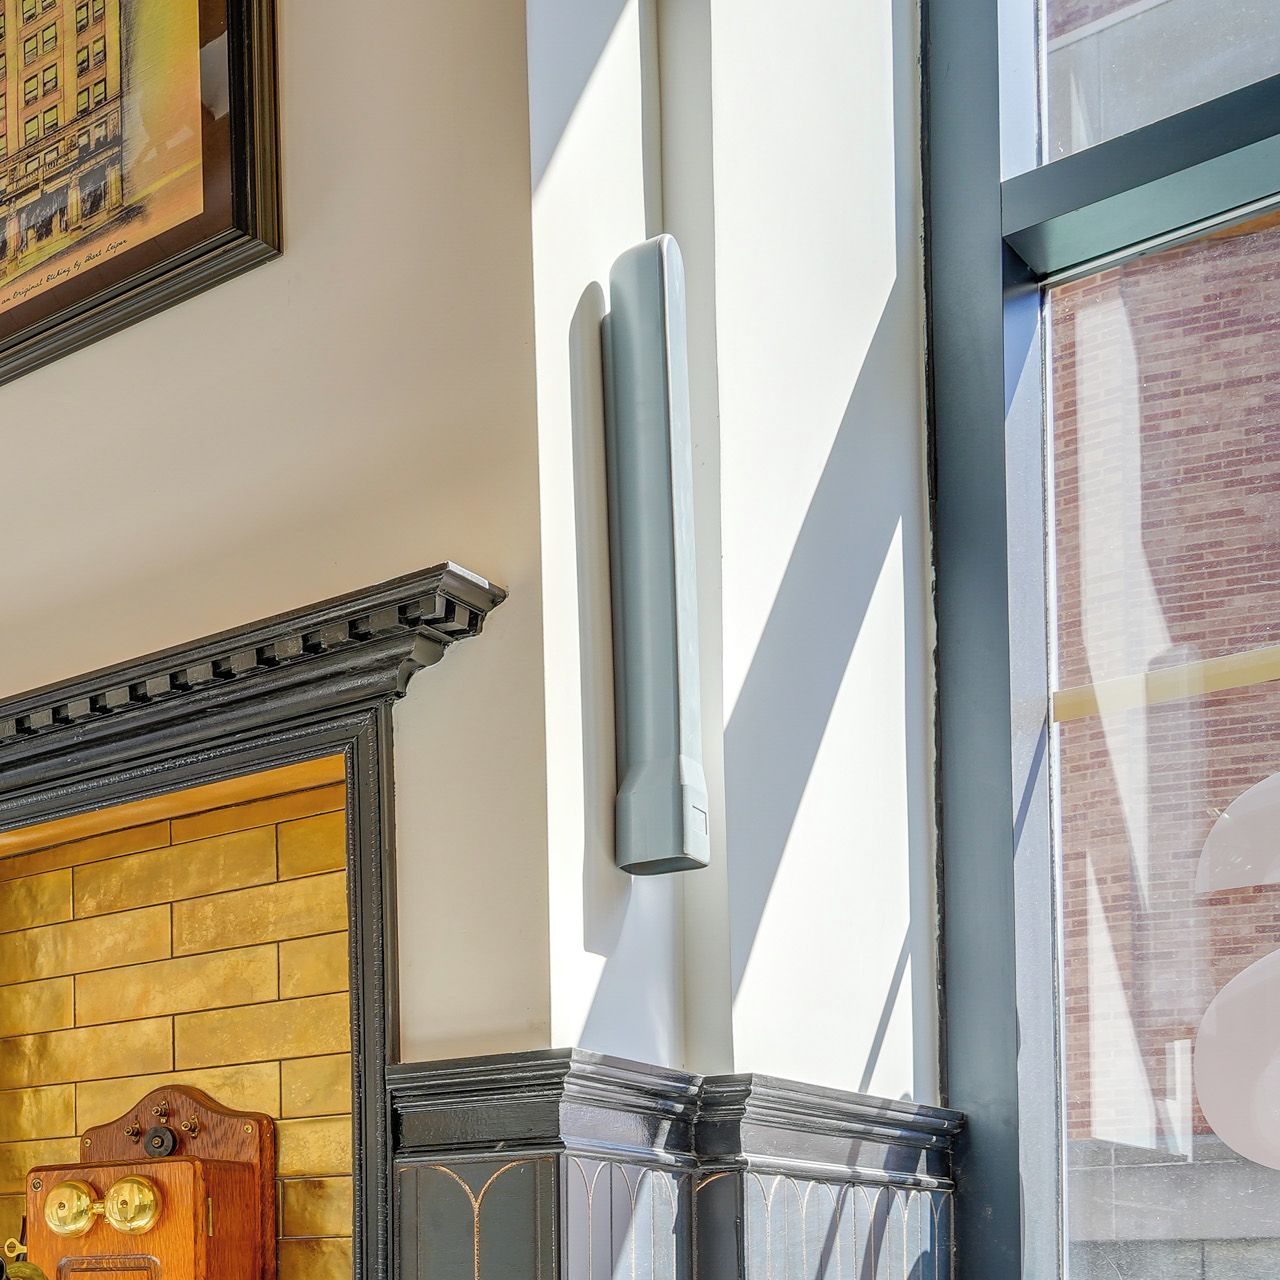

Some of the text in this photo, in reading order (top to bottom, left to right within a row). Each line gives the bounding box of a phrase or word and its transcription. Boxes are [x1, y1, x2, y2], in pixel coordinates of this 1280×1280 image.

[12, 278, 43, 298] Original
[45, 266, 72, 283] Etching
[73, 260, 82, 271] by
